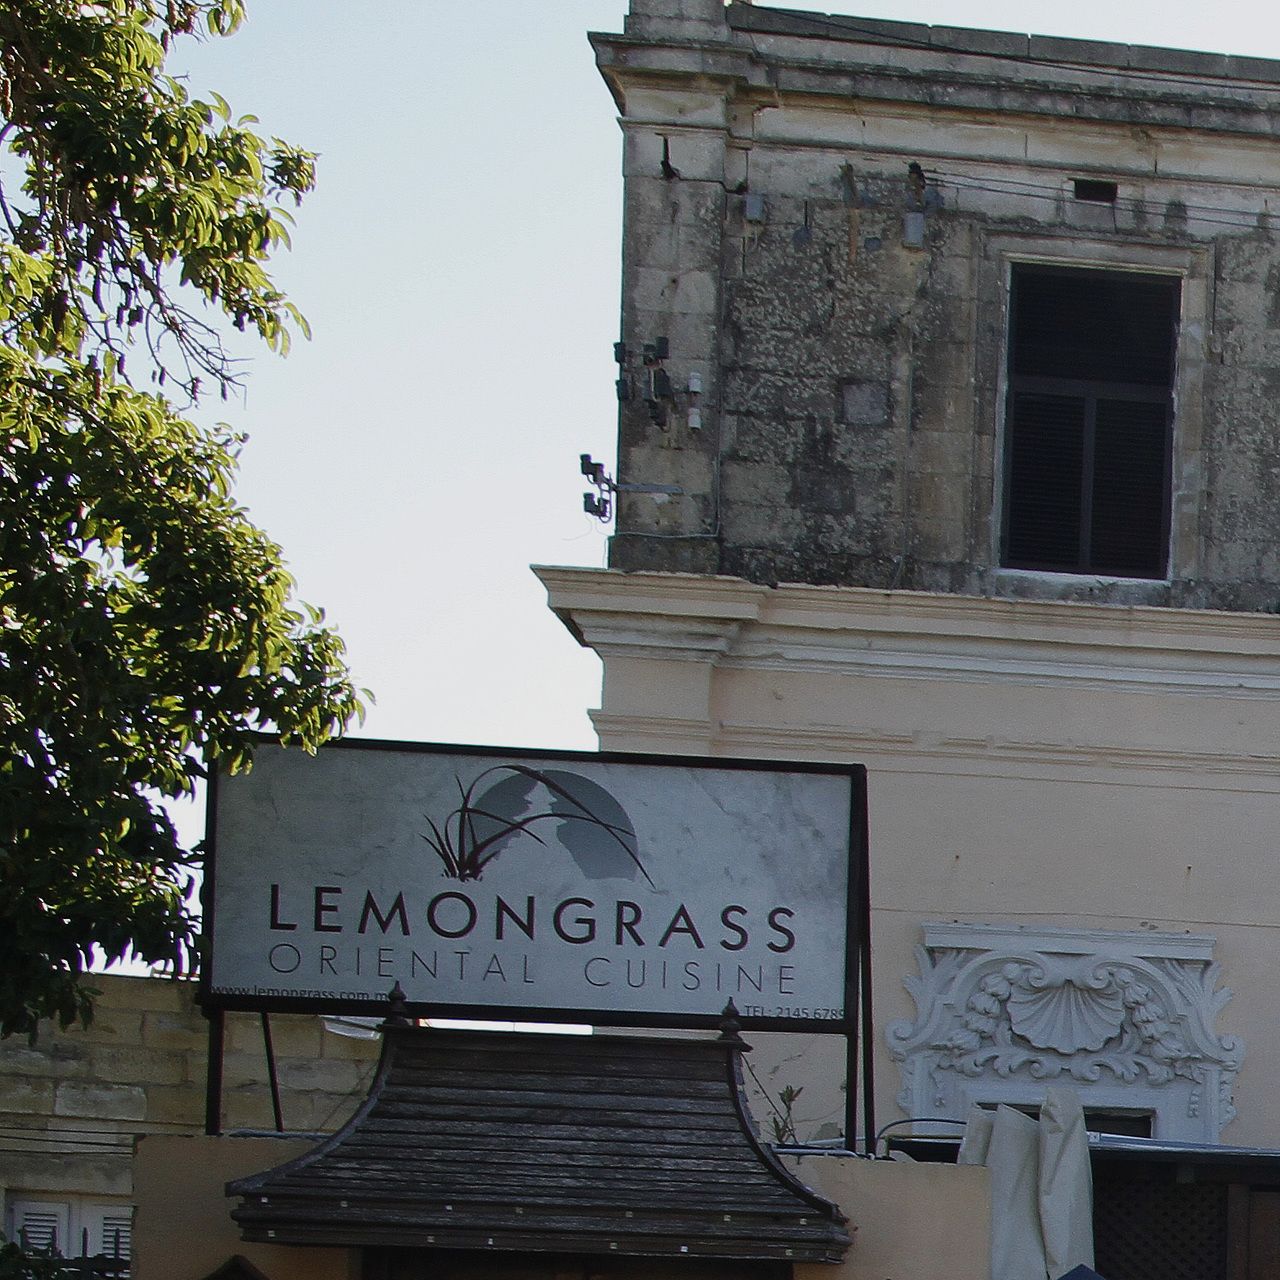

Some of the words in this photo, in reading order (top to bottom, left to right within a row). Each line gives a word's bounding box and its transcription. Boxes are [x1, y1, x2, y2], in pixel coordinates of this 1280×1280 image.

[268, 882, 797, 954] LEMONGRASS
[268, 943, 535, 985] ORIENTAL
[584, 956, 795, 995] CUISINE
